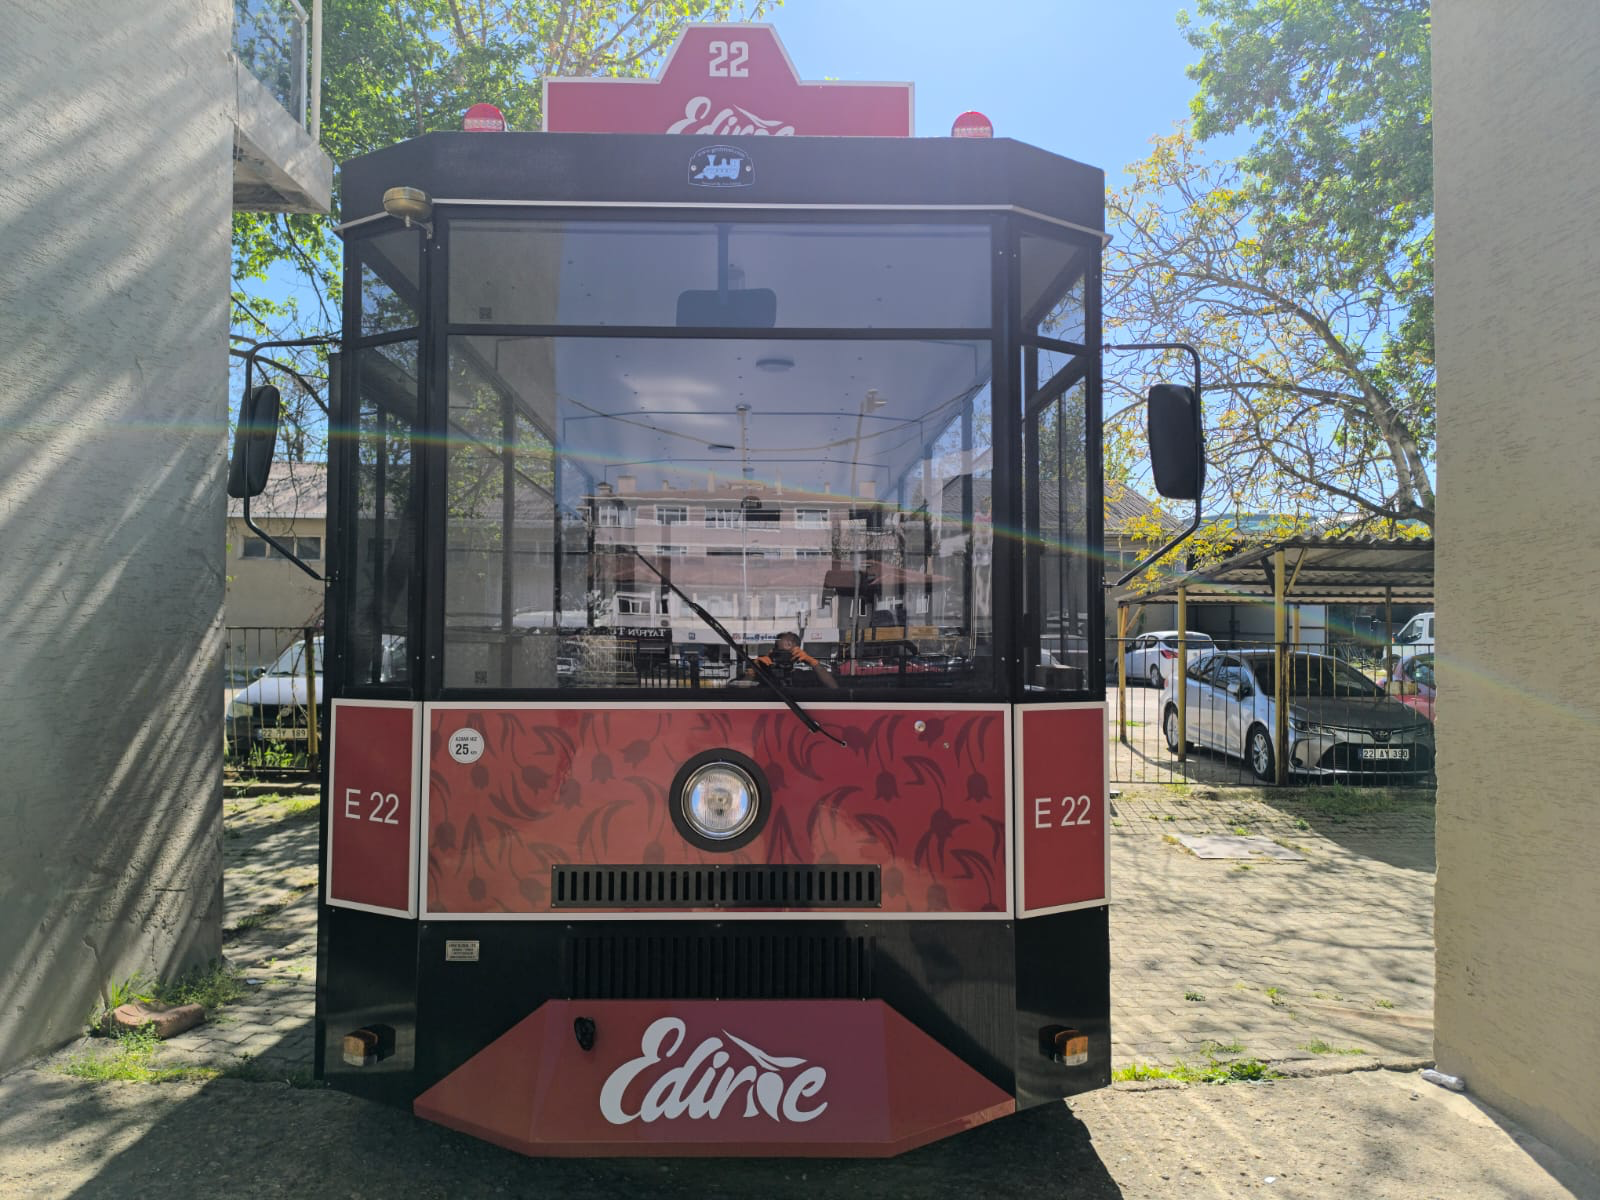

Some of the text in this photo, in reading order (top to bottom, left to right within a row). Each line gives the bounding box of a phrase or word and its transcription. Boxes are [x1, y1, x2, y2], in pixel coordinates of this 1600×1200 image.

[709, 41, 749, 78] 22
[455, 743, 469, 756] 25
[1363, 750, 1374, 758] 22
[345, 788, 399, 825] E 22
[1035, 795, 1091, 829] E 22
[600, 1016, 828, 1125] Edirne
